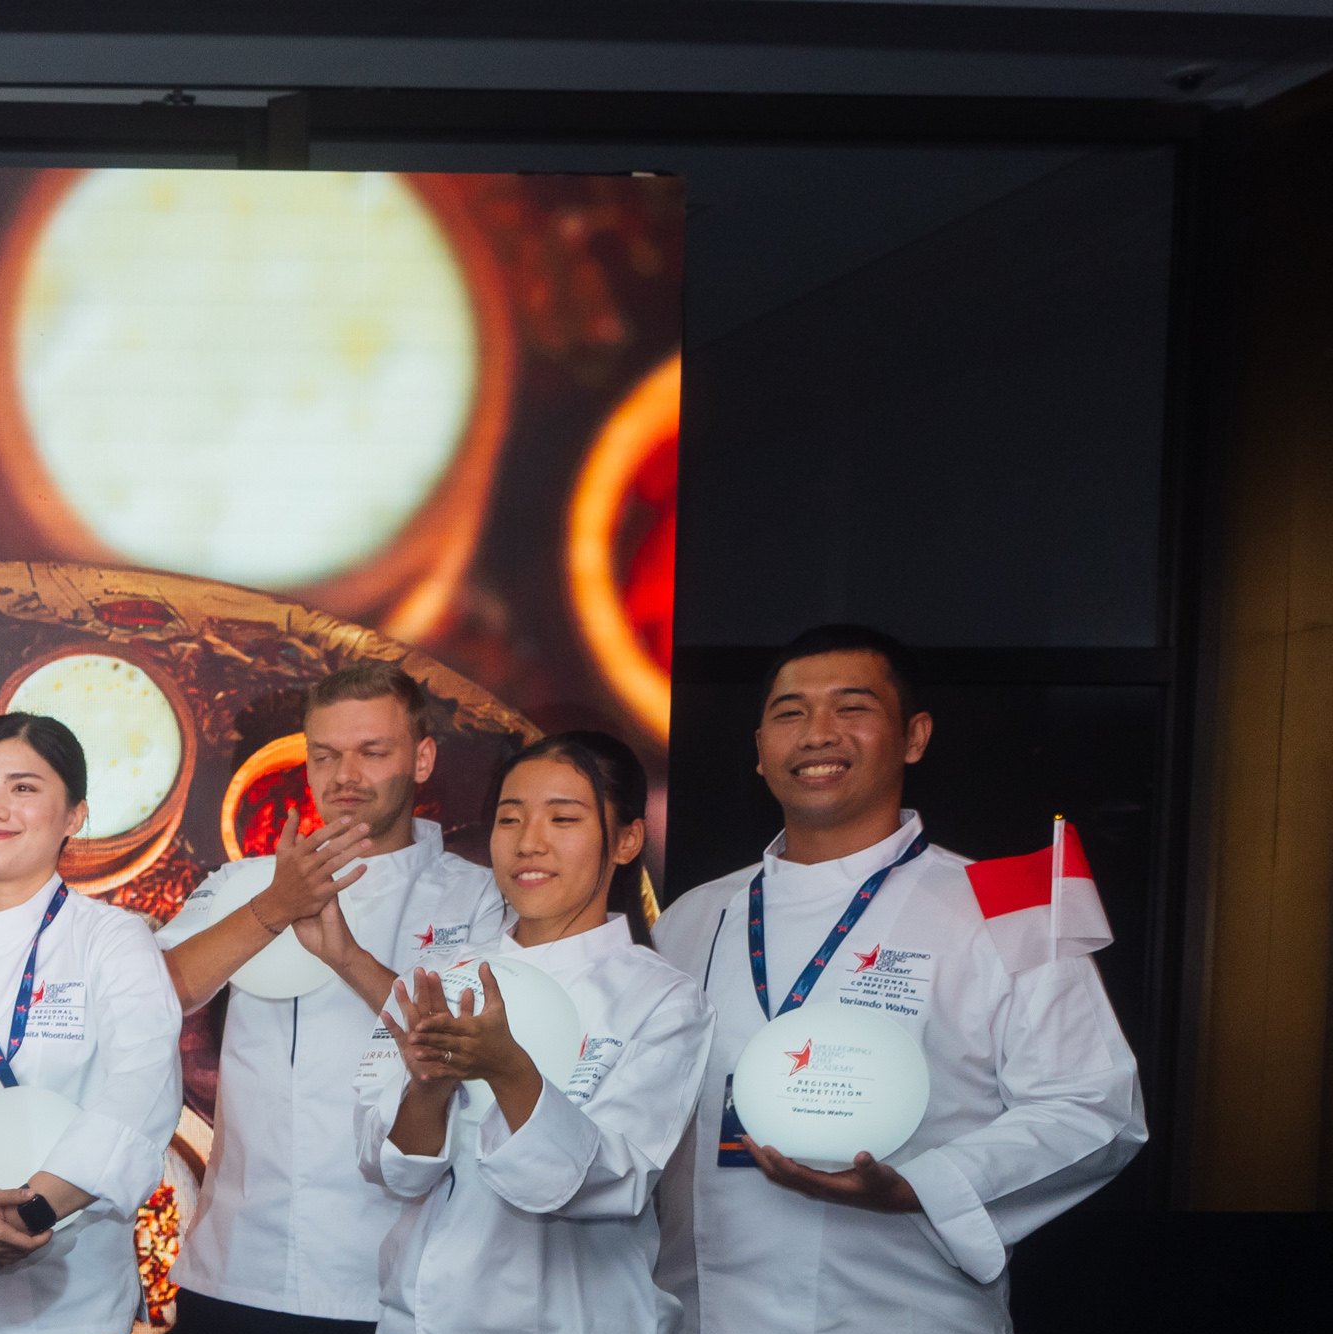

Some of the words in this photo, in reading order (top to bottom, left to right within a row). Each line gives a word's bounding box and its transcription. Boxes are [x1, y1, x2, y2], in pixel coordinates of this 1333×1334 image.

[874, 965, 913, 975] ACADEMY
[861, 975, 909, 987] REGIONAL
[850, 980, 917, 995] COMPETITION
[839, 996, 883, 1010] Variando
[885, 1002, 919, 1016] Wahyu
[797, 1079, 853, 1089] REGIONAL
[786, 1086, 862, 1097] COMPETITION
